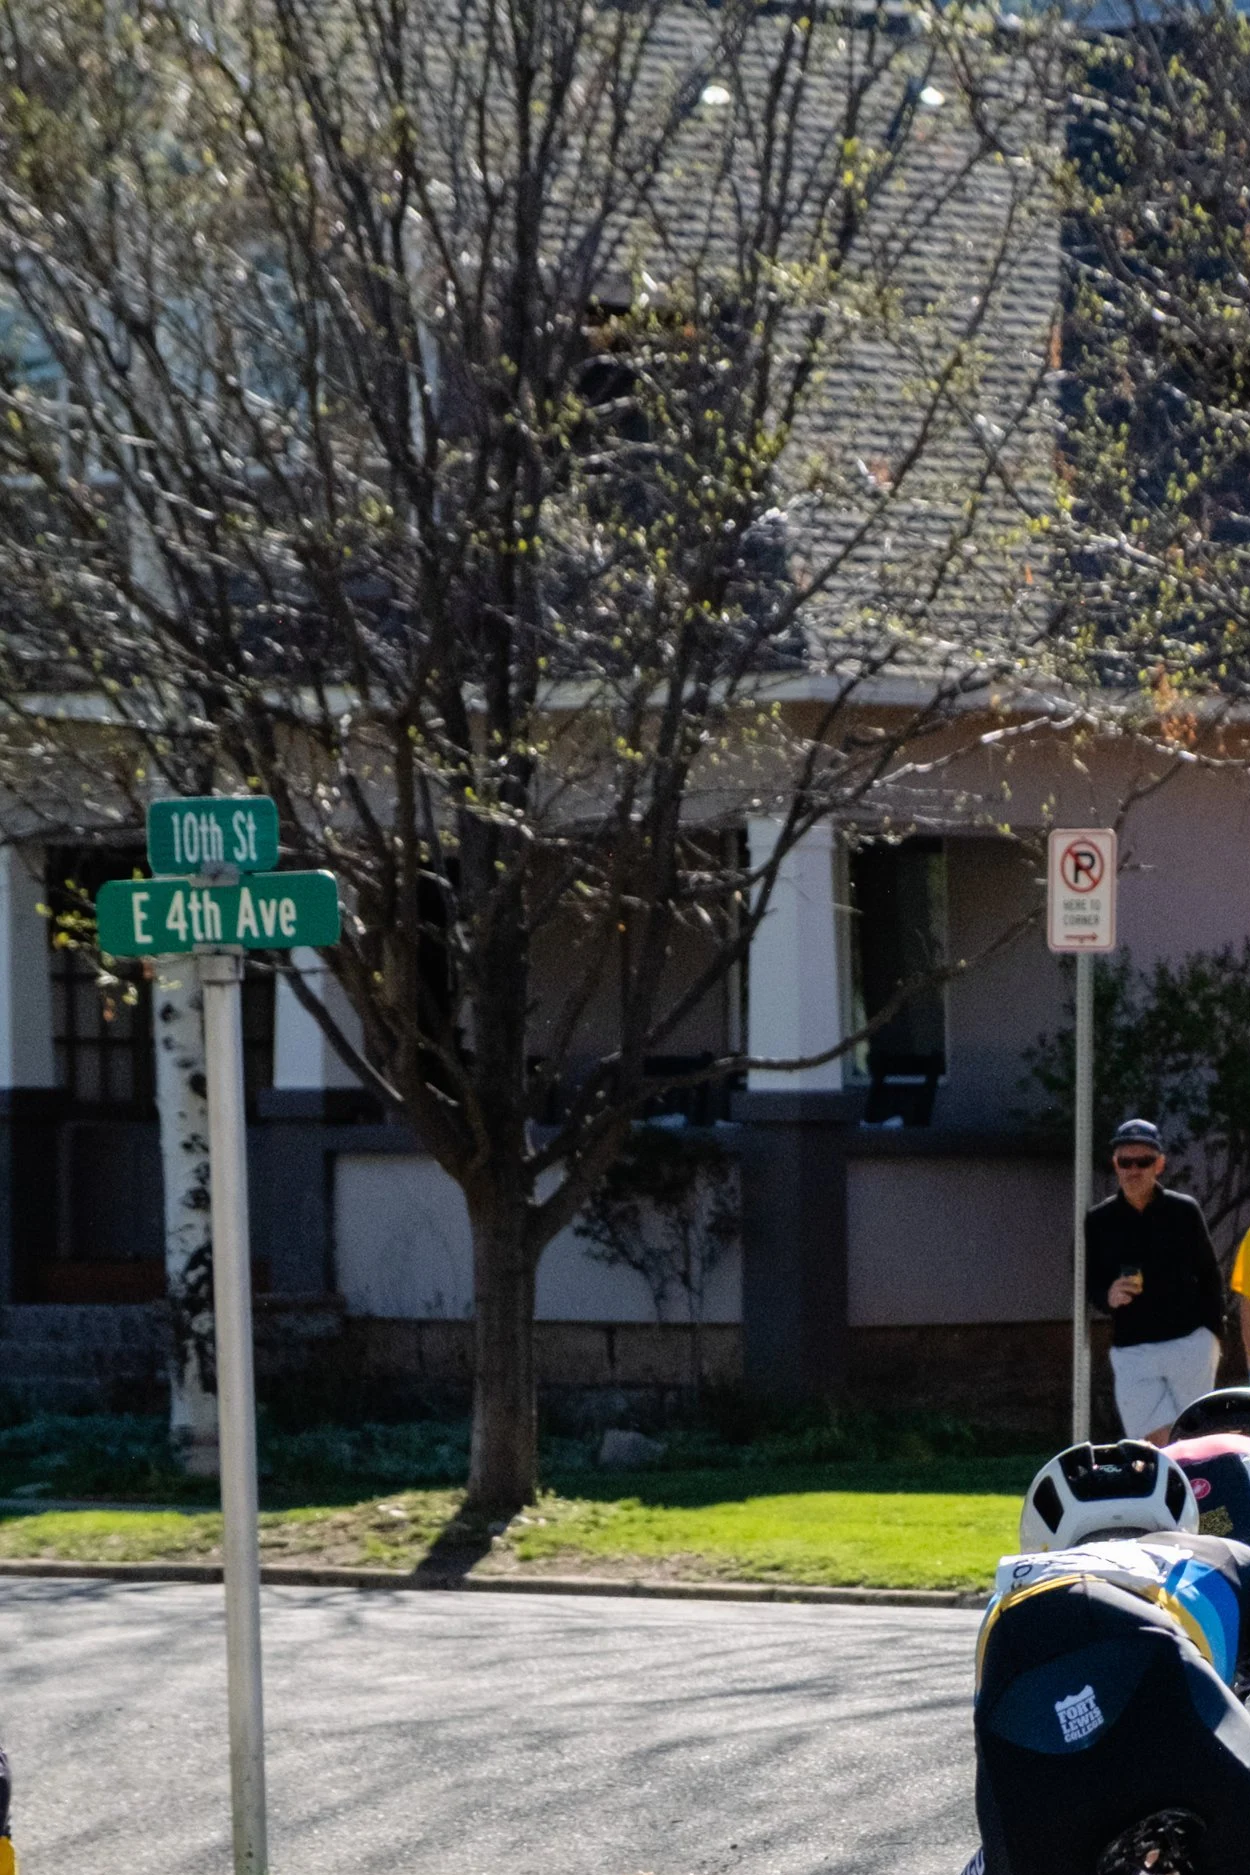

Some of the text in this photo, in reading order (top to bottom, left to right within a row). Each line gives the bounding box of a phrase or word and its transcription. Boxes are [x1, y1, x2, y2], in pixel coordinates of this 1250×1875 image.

[171, 810, 258, 863] 10th St
[131, 887, 297, 945] E 4th Ave
[1057, 1695, 1096, 1723] FORT
[1062, 1707, 1101, 1734] LEWIS
[1064, 1716, 1104, 1743] COLLEGE
